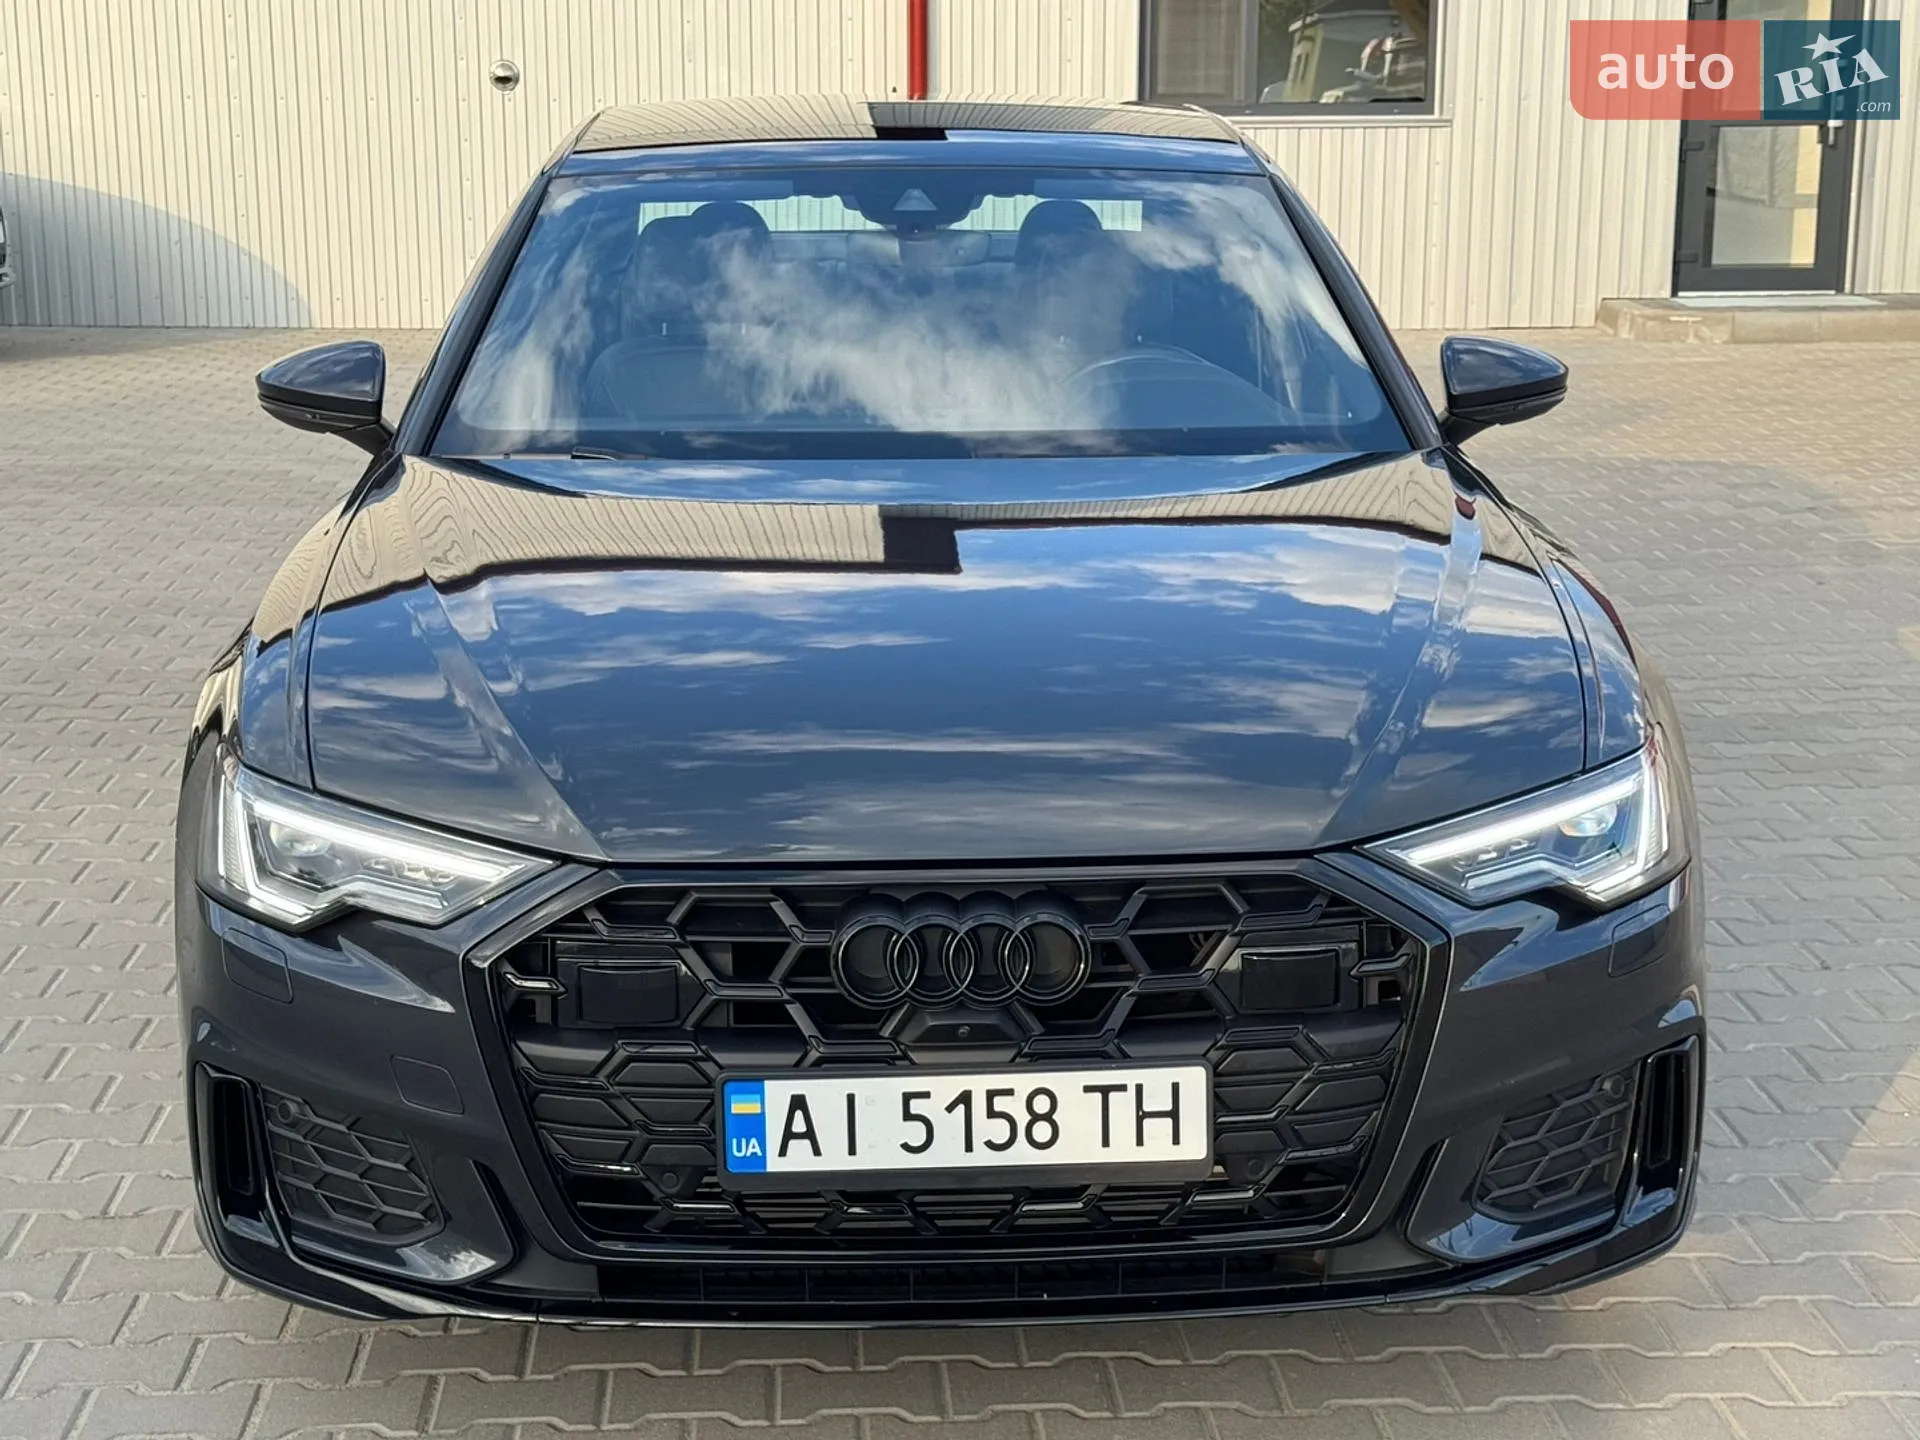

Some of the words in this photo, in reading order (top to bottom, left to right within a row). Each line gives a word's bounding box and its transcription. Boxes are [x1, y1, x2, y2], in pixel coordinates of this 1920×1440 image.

[778, 1093, 857, 1157] AI
[900, 1086, 1060, 1155] 5158
[1083, 1081, 1181, 1148] TH
[732, 1137, 762, 1157] UA
